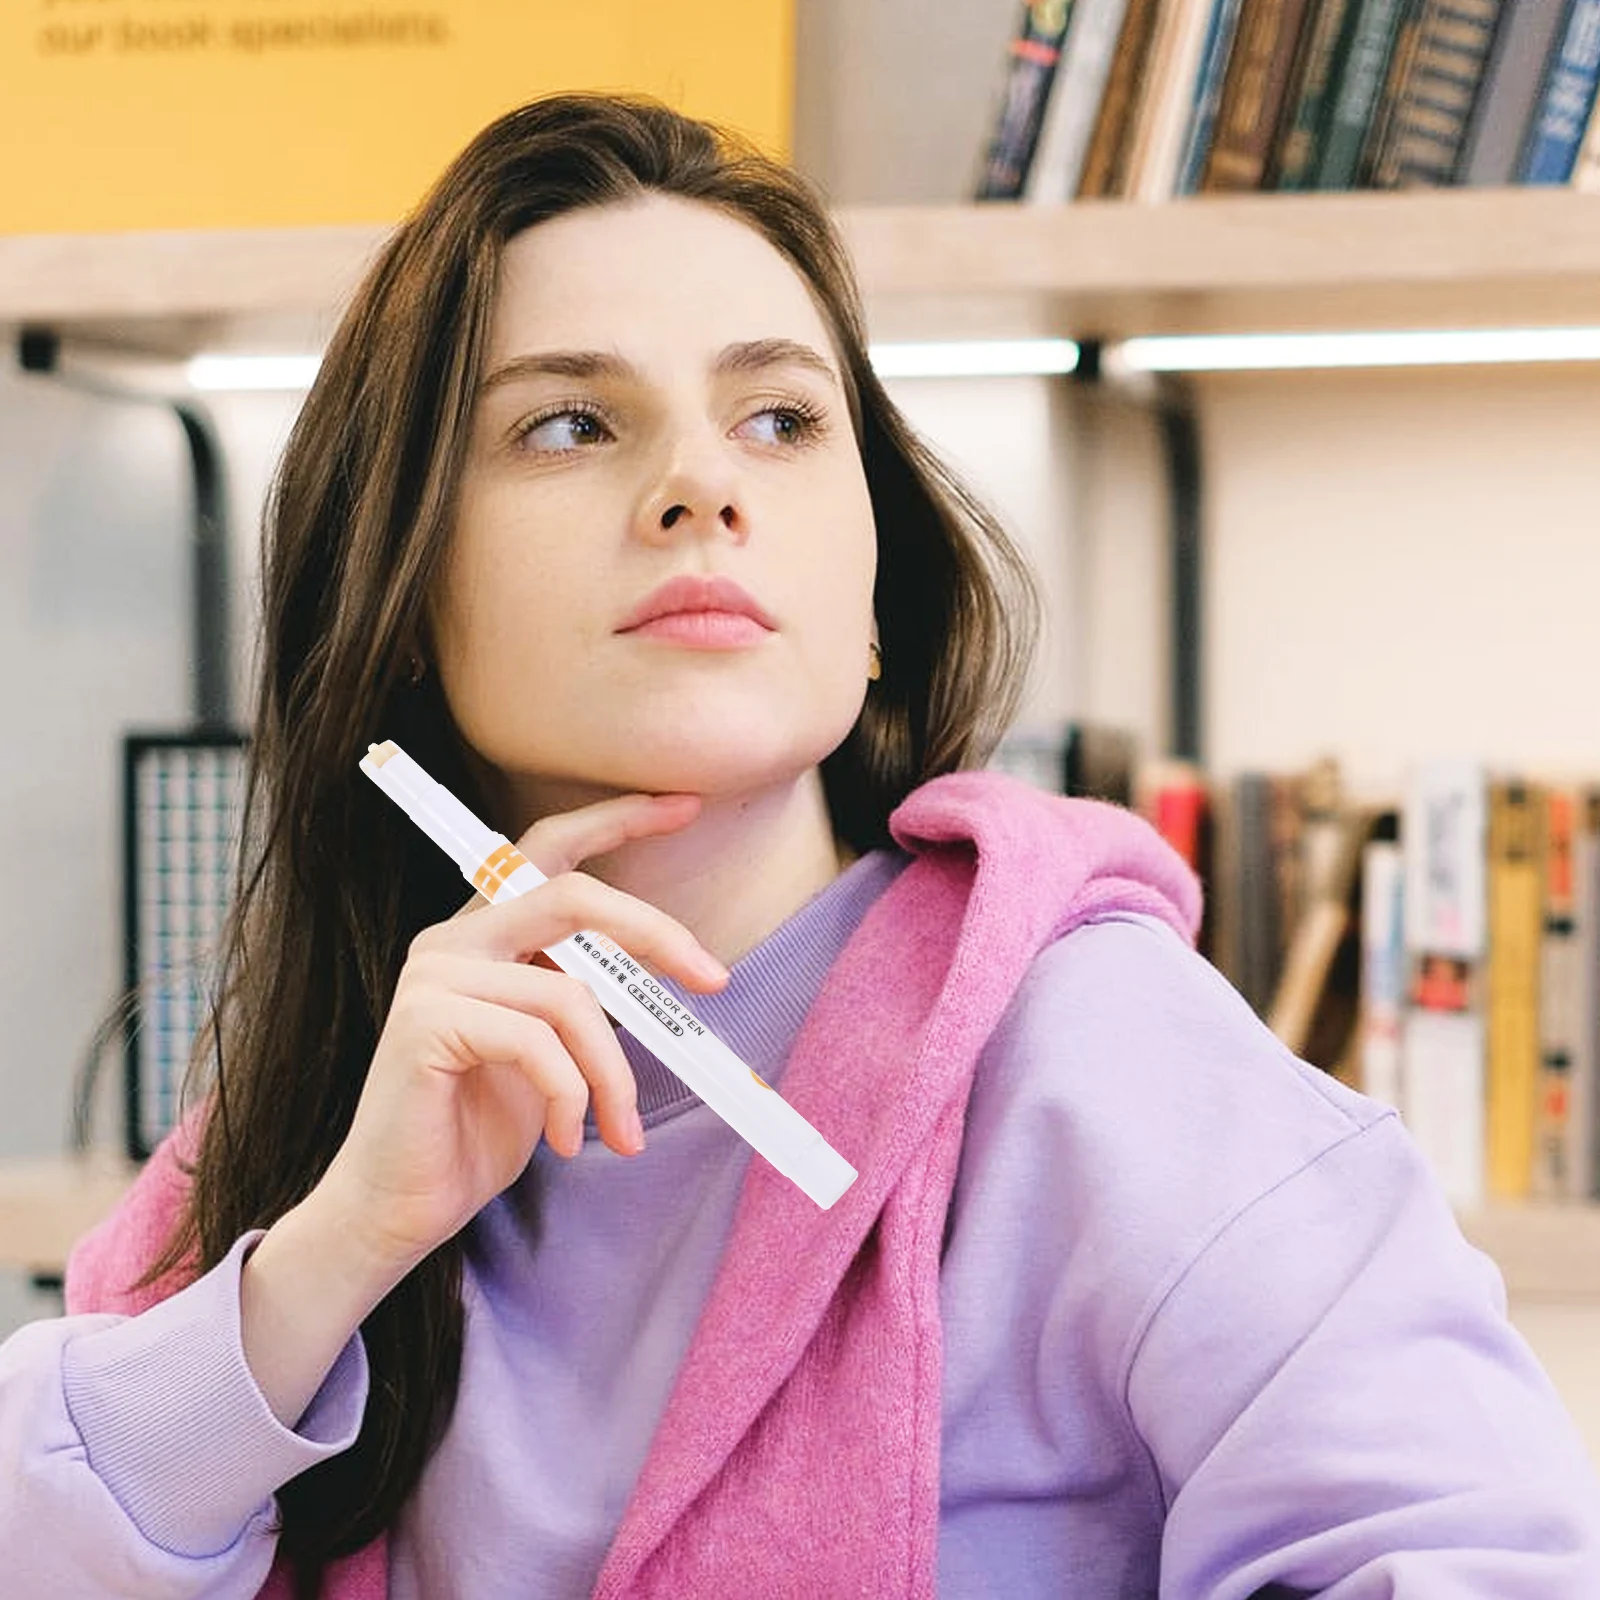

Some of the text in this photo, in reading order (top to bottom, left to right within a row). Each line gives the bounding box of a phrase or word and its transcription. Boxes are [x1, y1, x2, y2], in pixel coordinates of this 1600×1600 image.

[613, 951, 641, 977] LINE
[642, 978, 681, 1014] COLOR
[680, 1013, 705, 1036] PEN
